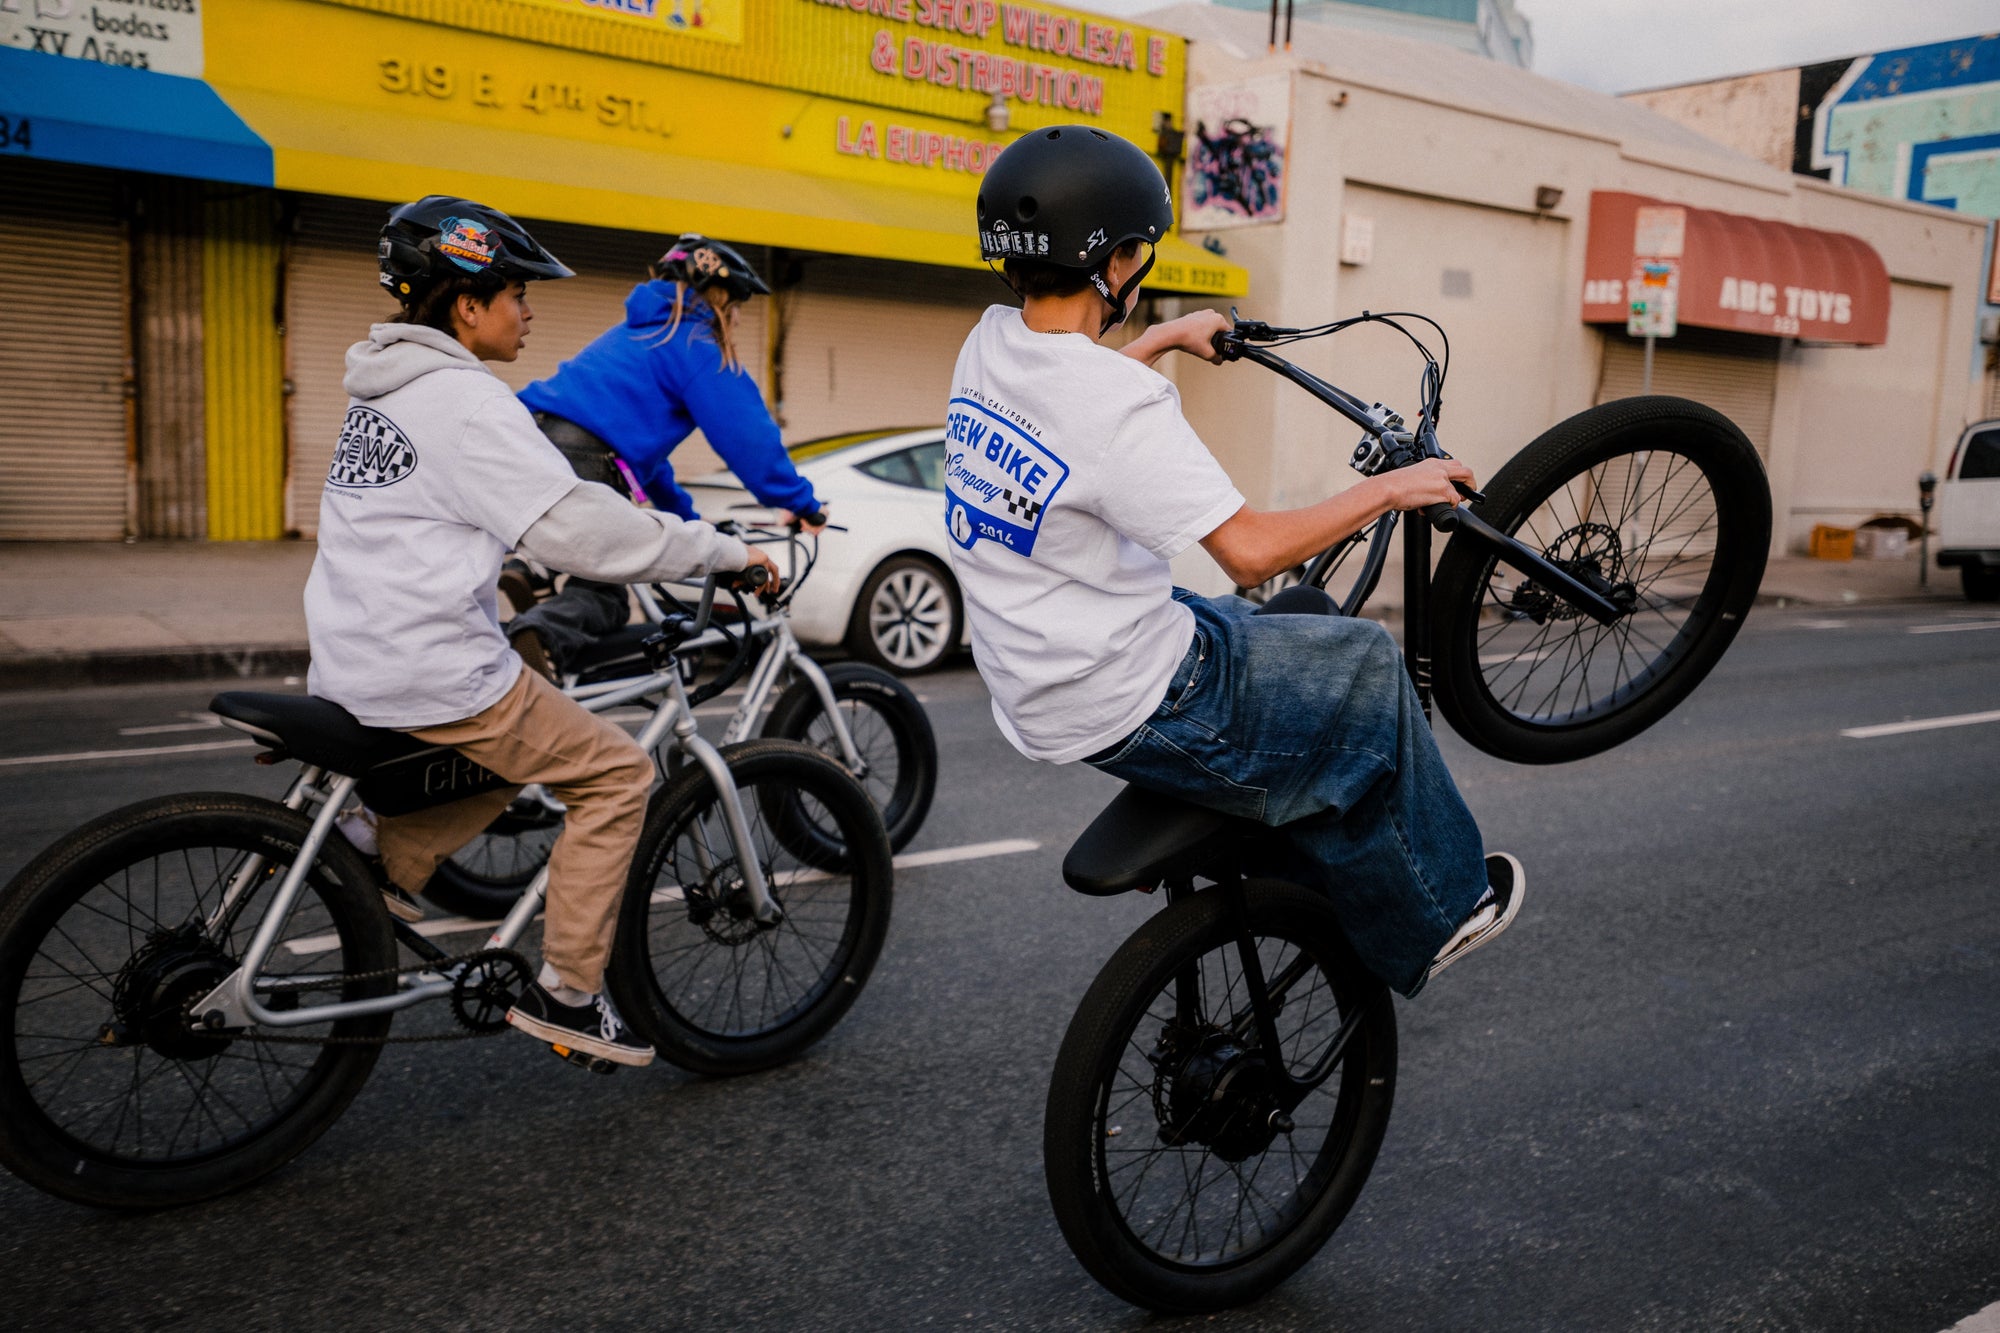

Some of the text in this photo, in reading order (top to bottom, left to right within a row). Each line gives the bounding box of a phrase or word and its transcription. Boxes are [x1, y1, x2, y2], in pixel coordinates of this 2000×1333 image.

[92, 7, 169, 41] bodas
[916, 0, 996, 38] SHOP
[871, 30, 1103, 115] & DISTRIBUTION
[838, 116, 880, 158] LA
[1719, 276, 1777, 315] ABC
[1784, 286, 1852, 324] TOYS
[987, 398, 1043, 439] CALIFORNIA
[946, 412, 1049, 496] CREW BIKE
[946, 452, 1003, 504] Company
[978, 521, 1015, 546] 2014
